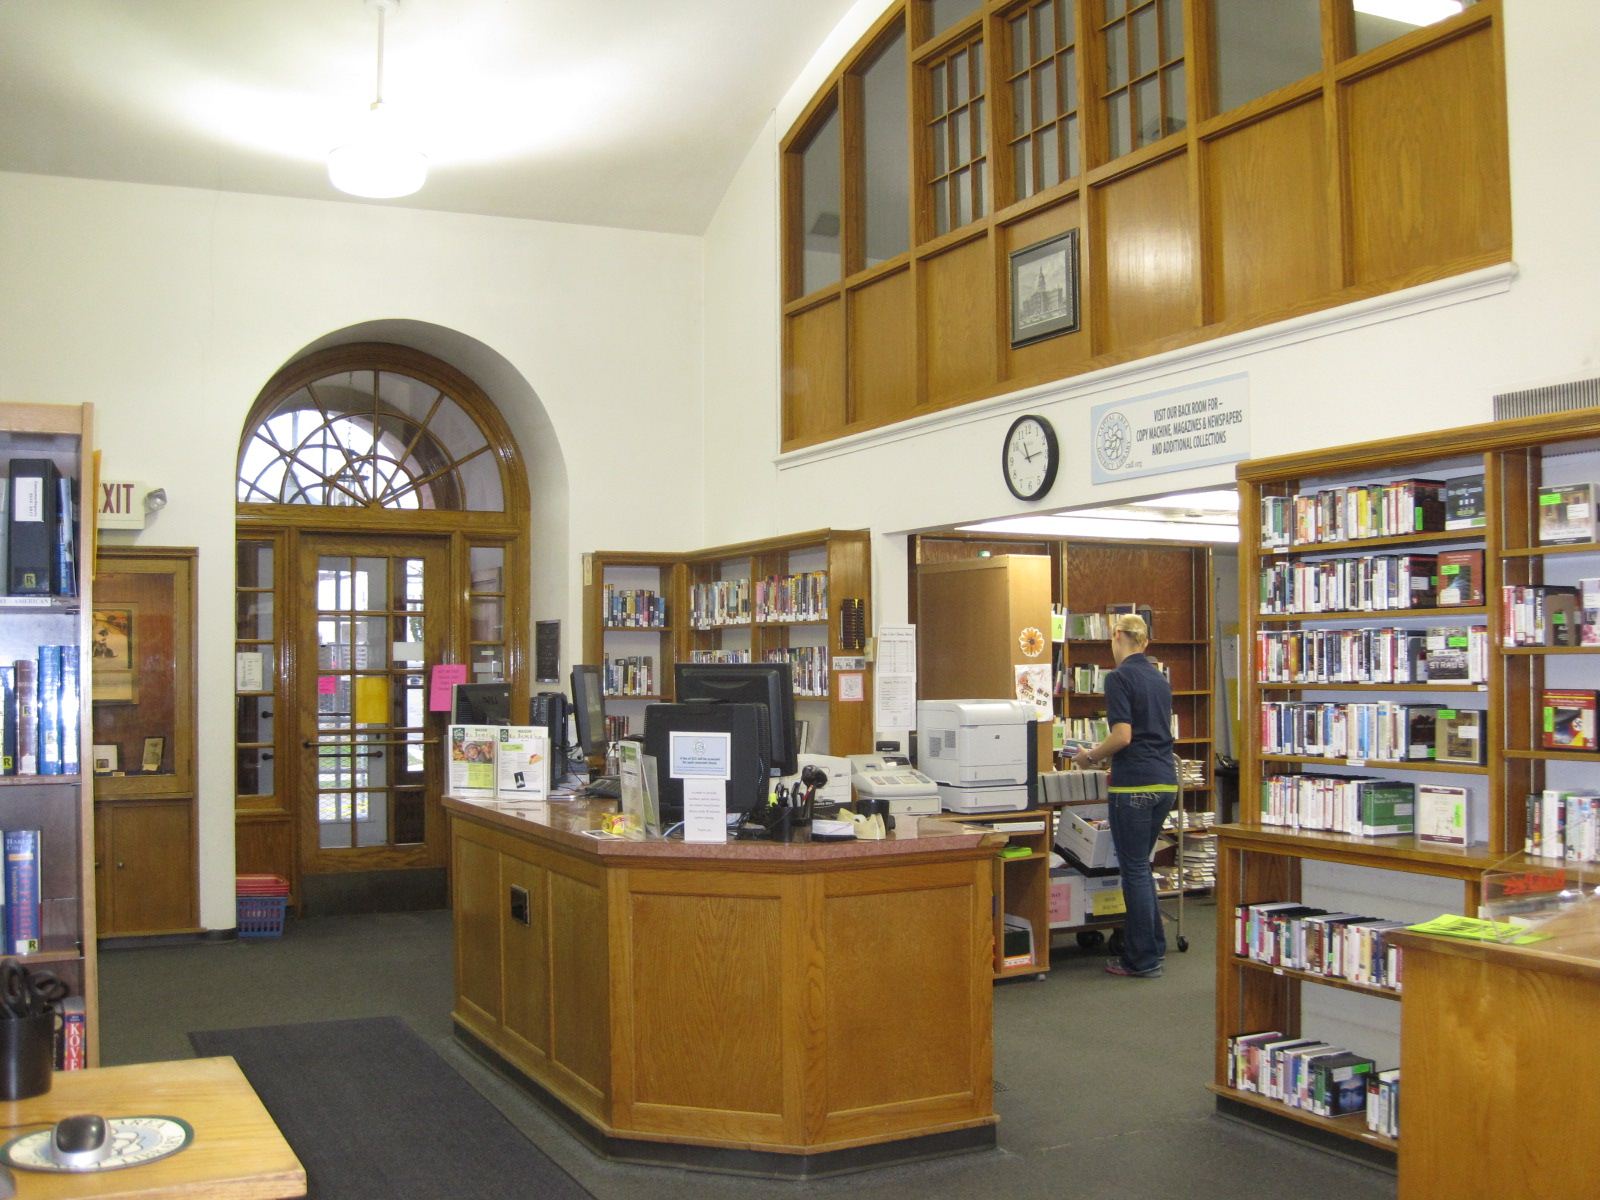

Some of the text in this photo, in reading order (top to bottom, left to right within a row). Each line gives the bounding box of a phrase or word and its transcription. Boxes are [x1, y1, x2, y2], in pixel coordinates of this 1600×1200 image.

[1154, 408, 1166, 422] VISIT
[1167, 406, 1177, 419] OUR
[1178, 403, 1192, 417] BACK
[1192, 400, 1207, 414] ROOM
[1208, 397, 1218, 411] FOR
[1018, 430, 1024, 440] 11
[1025, 425, 1031, 435] 12
[1136, 427, 1148, 442] COPY
[1173, 418, 1202, 435] MAGAZINES
[1202, 417, 1206, 430] &
[1207, 410, 1243, 428] NEWSPAPERS
[1152, 430, 1227, 456] AND ADDITIONAL COLLECTIONS
[99, 483, 134, 513] XIT
